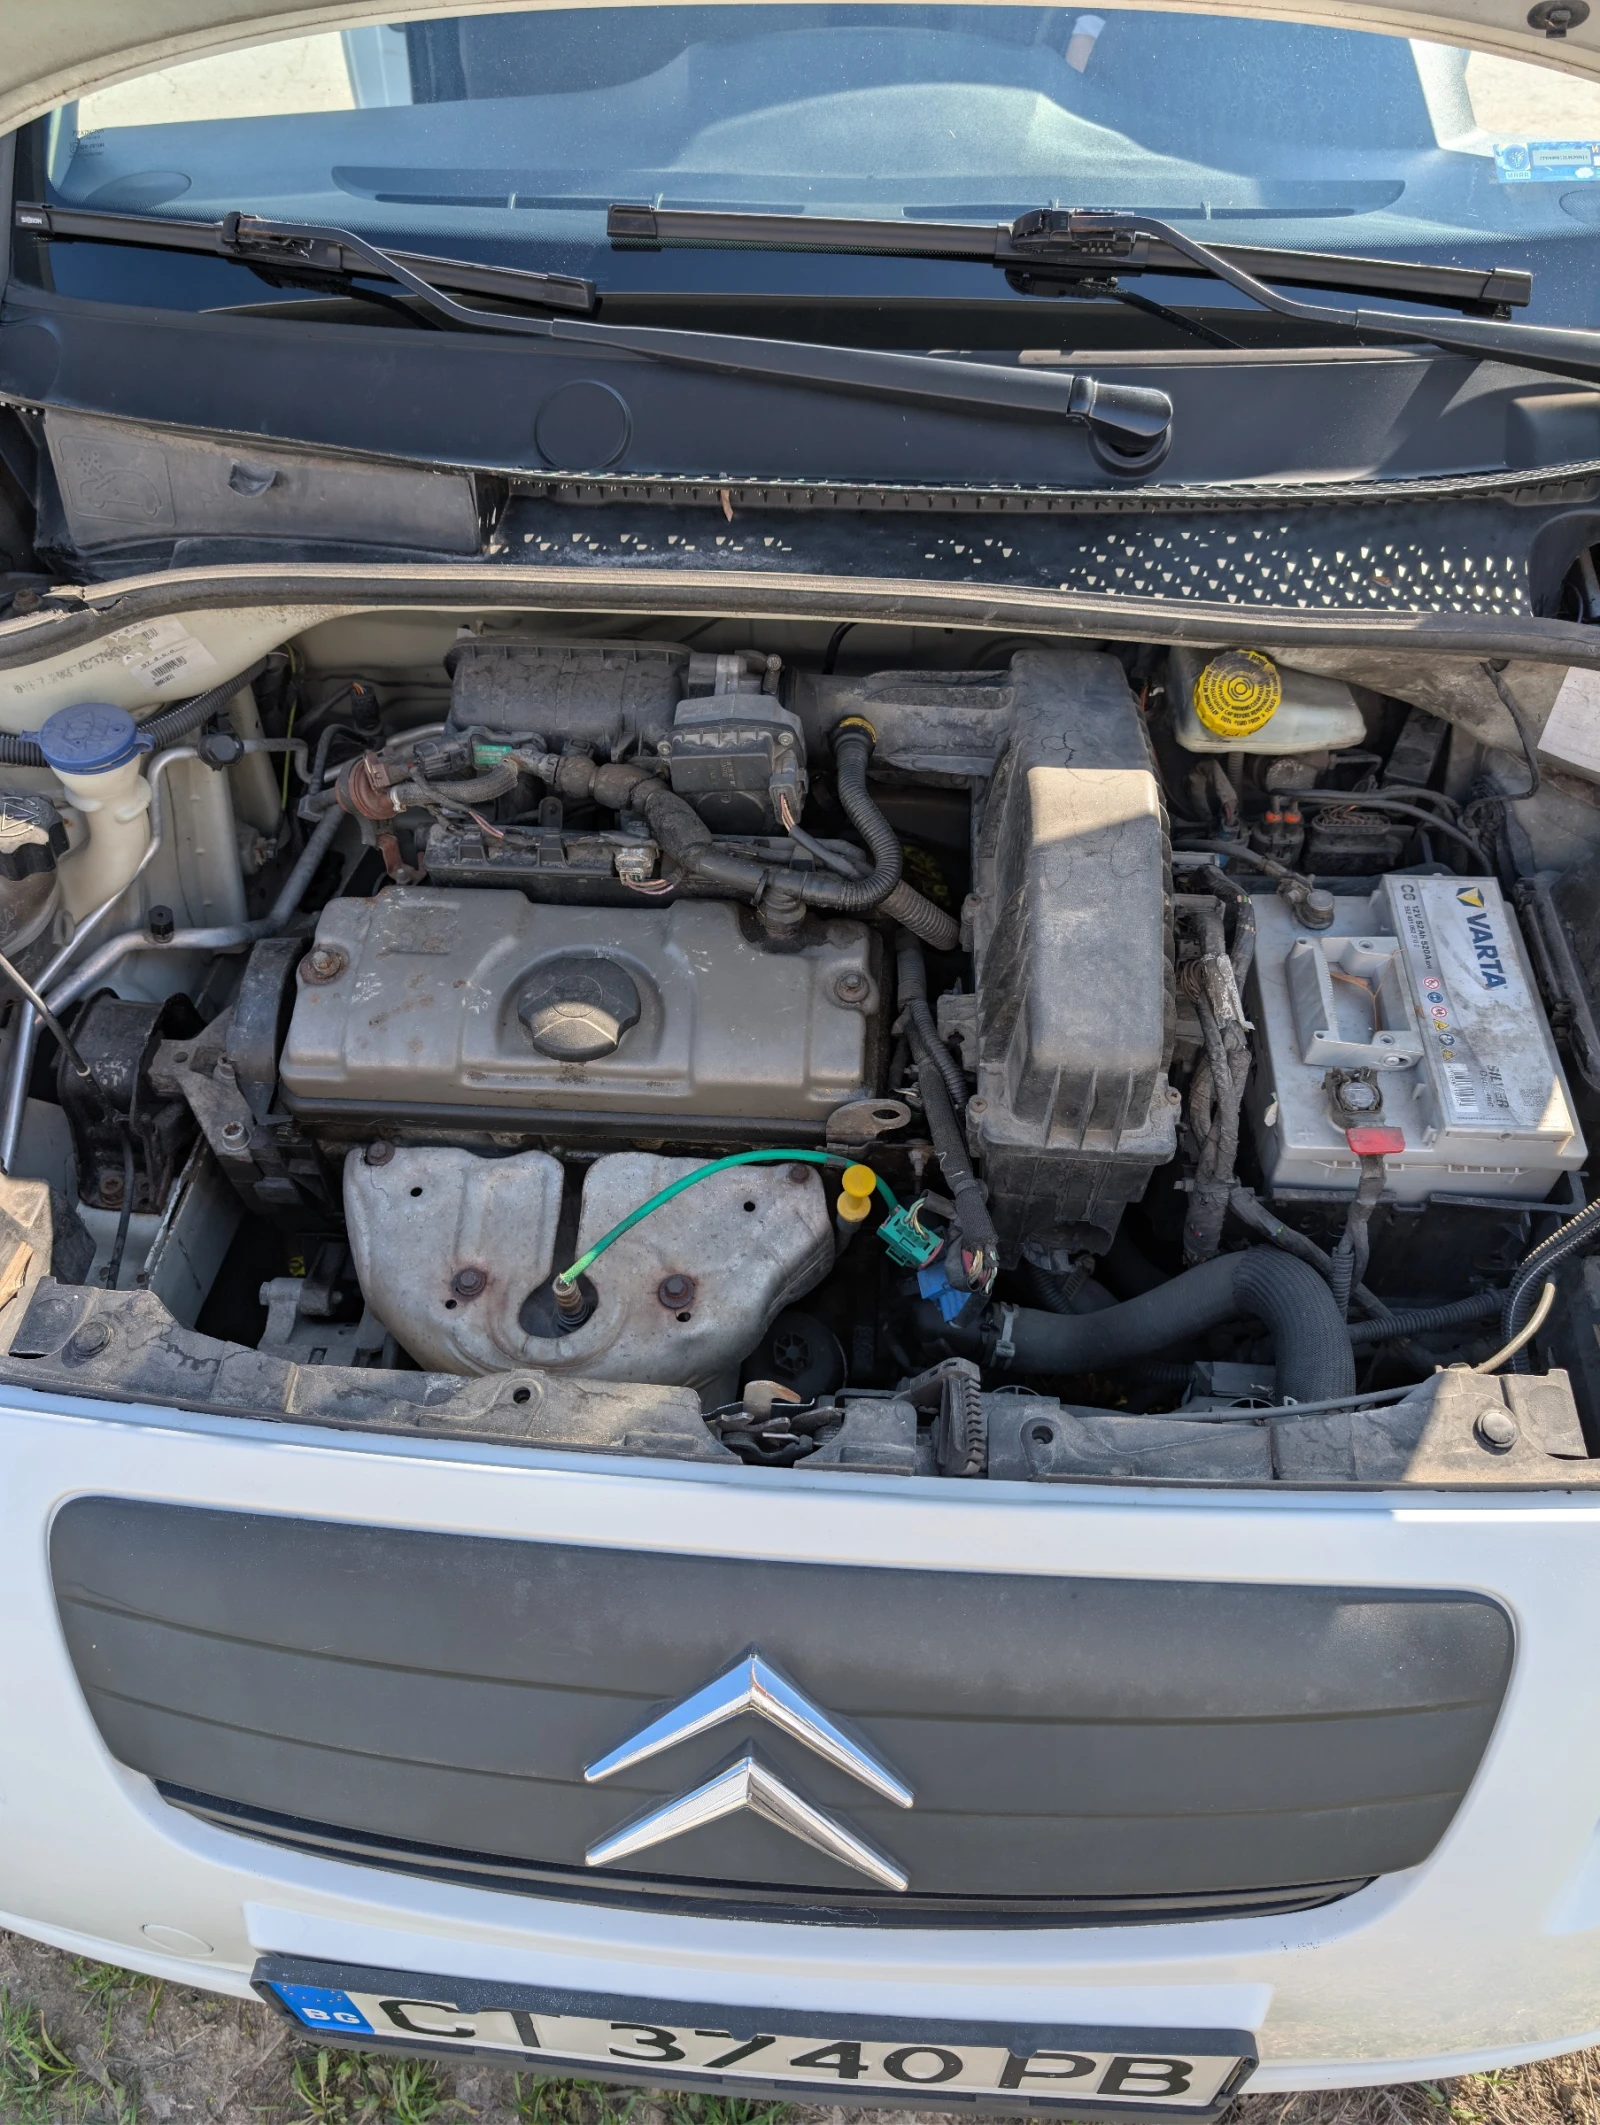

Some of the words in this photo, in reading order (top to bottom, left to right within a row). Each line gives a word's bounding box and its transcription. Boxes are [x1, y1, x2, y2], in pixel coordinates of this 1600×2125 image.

[1412, 905, 1422, 919] 12V
[1416, 920, 1426, 940] 52Ah
[1466, 912, 1507, 988] VARTA
[302, 2007, 361, 2024] BG
[378, 1999, 560, 2048] CT
[608, 2022, 963, 2085] 3740
[998, 2052, 1194, 2098] PB
